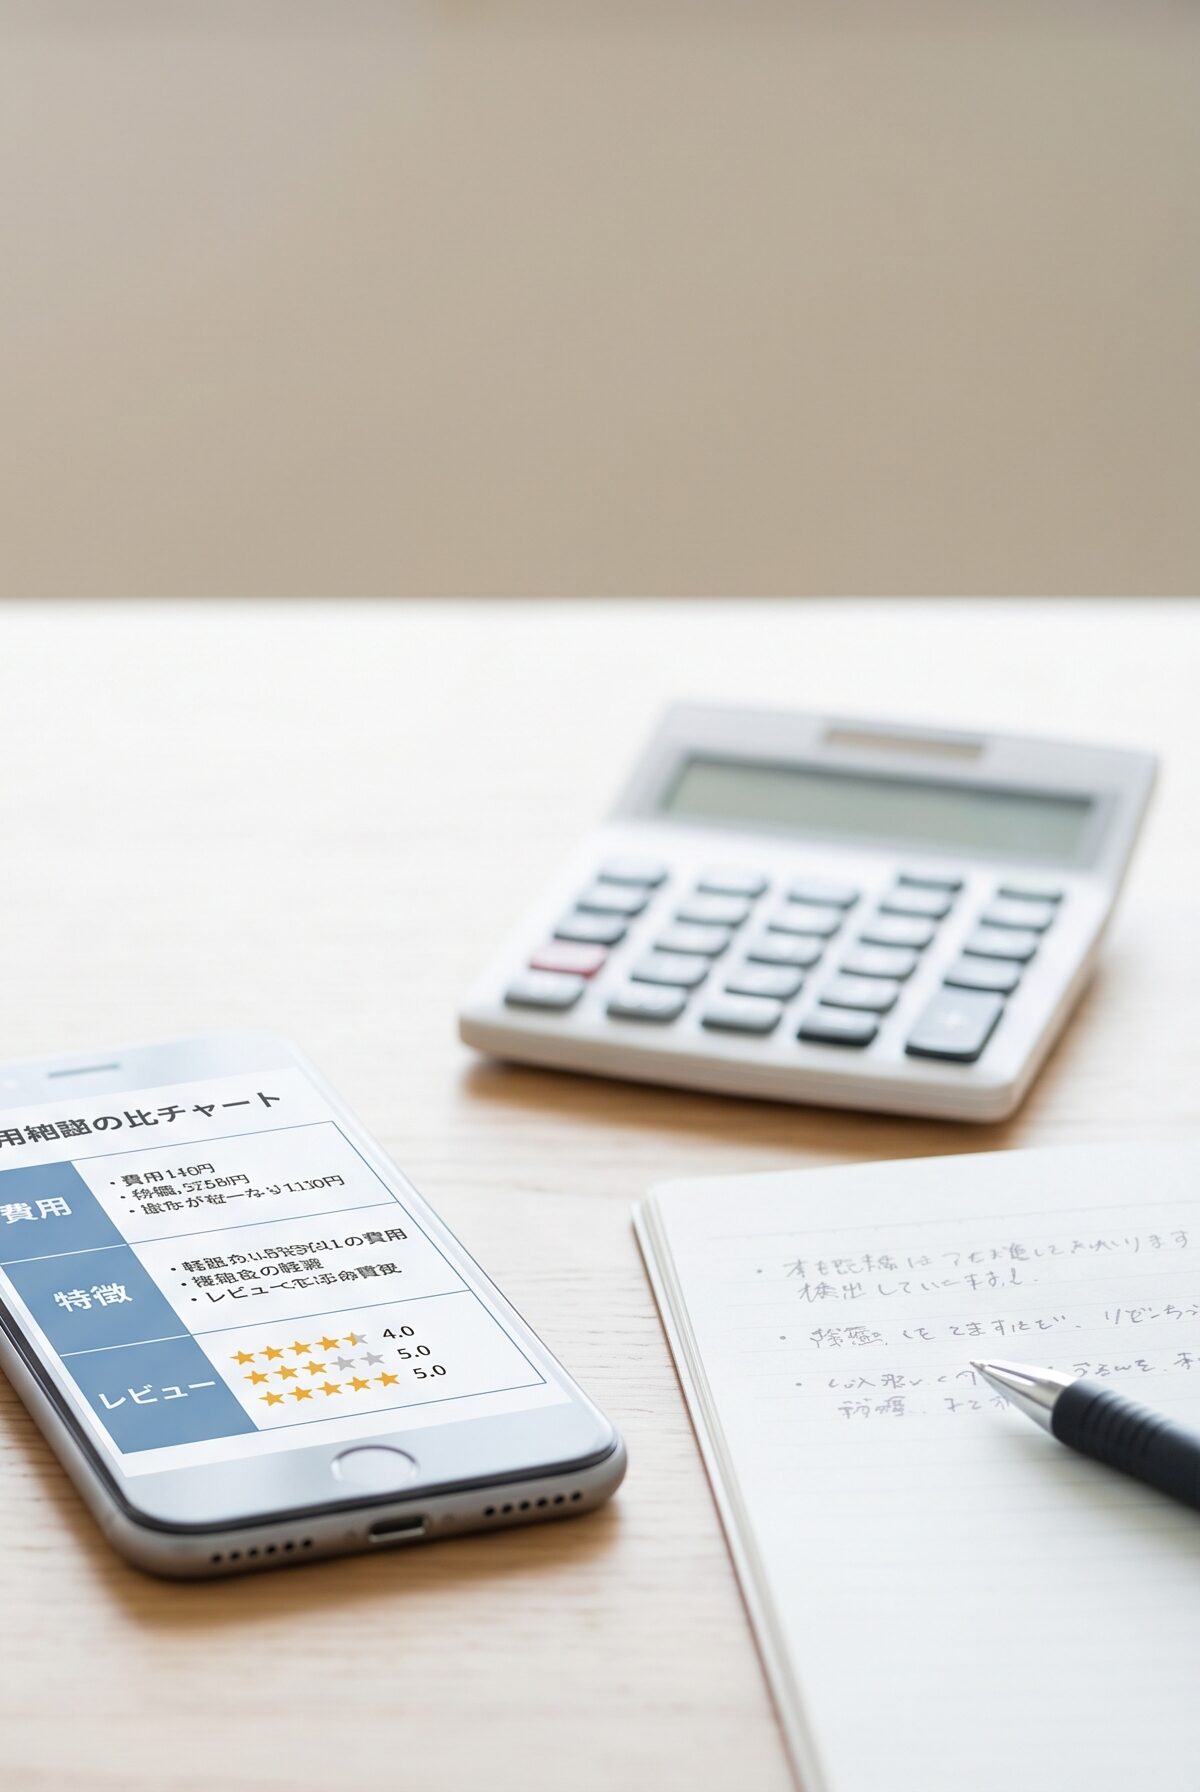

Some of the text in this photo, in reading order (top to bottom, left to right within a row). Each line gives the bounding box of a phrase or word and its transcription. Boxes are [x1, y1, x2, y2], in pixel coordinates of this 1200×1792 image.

[54, 1282, 133, 1312] 特徴
[382, 1325, 415, 1339] 4.0
[397, 1345, 431, 1360] 5.0
[412, 1364, 447, 1379] 5.0
[98, 1381, 216, 1410] レビュー
